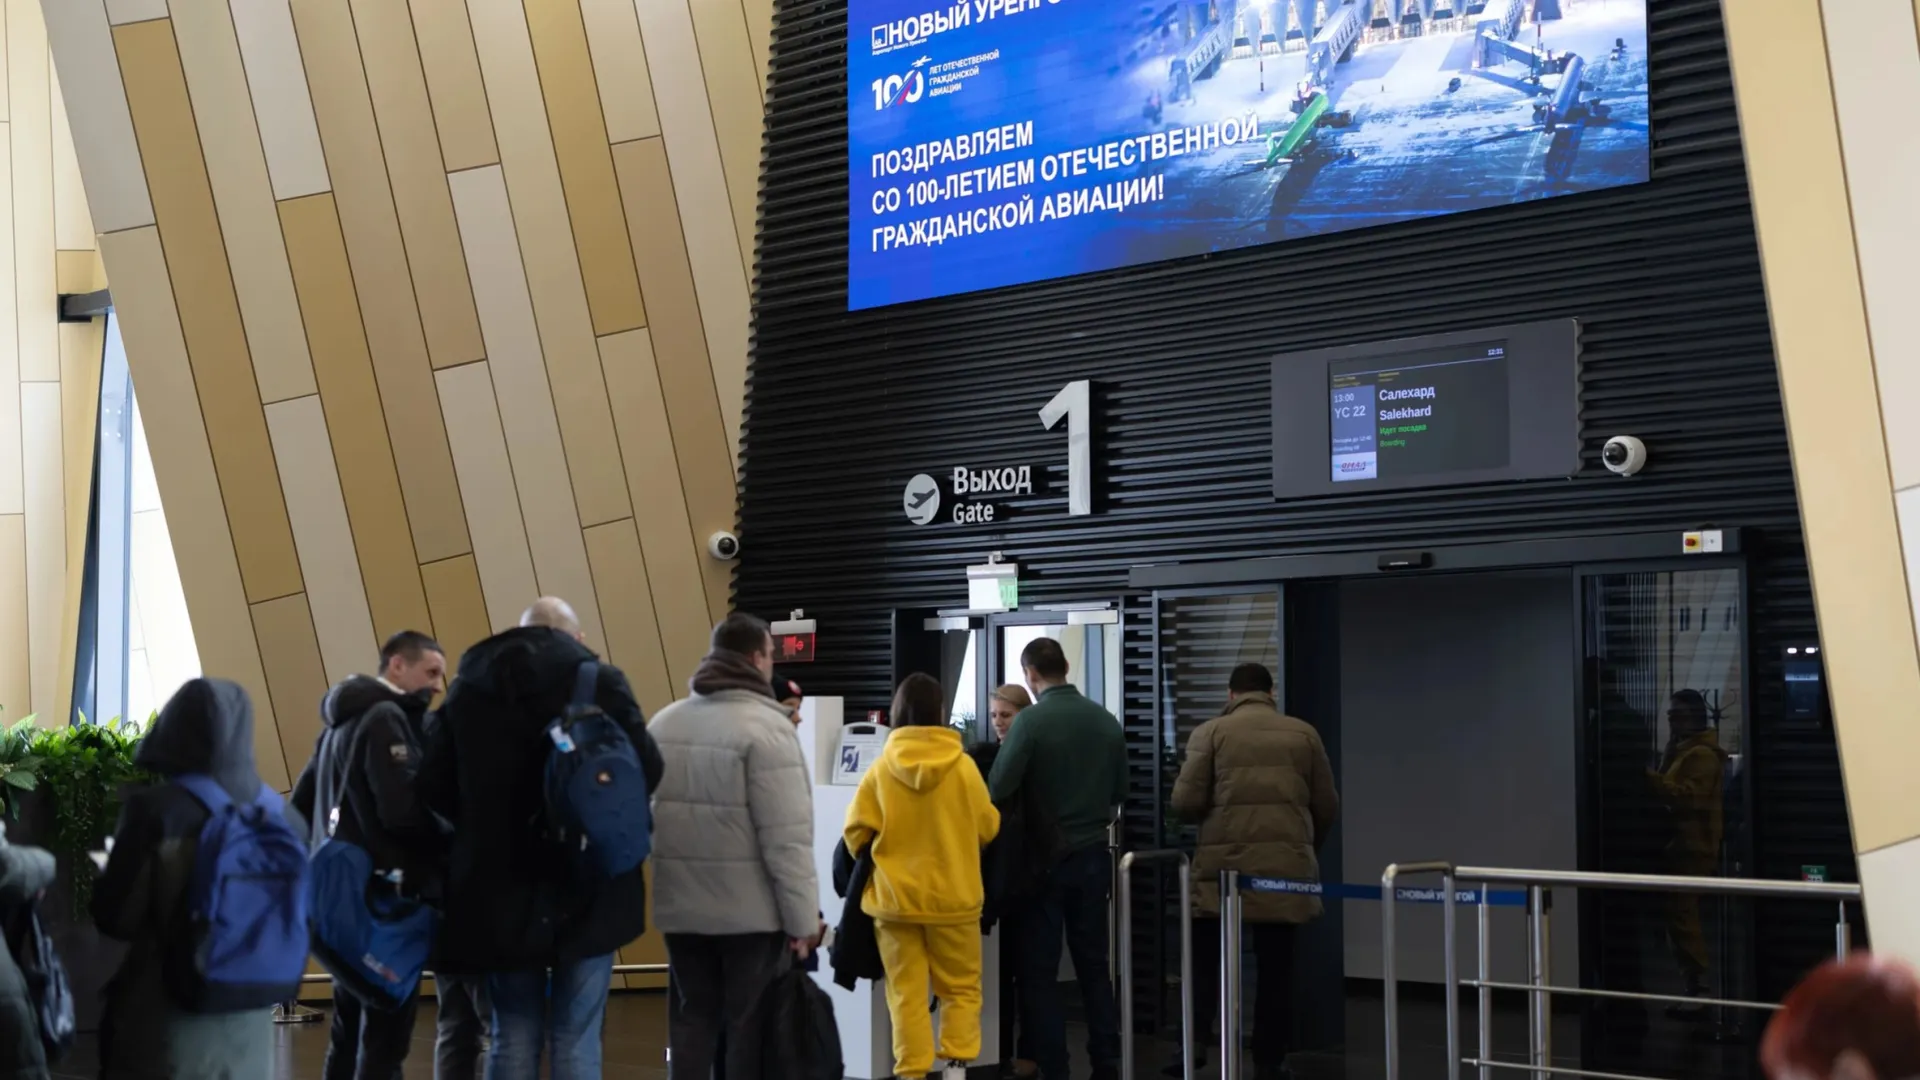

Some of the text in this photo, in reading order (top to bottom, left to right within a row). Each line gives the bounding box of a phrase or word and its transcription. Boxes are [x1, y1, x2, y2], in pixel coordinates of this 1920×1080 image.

[889, 0, 1061, 46] НОВЫЙ УРЕ
[929, 49, 1000, 75] ЛЕТ ОТЕЧЕСТВЕННОЙ
[929, 65, 979, 86] ГРАЖДАНСКОЙ
[872, 69, 924, 111] 100
[929, 82, 962, 97] АВИАЦИИ
[872, 120, 1034, 178] ПОЗДРАВЛЯЕМ
[872, 108, 1259, 215] СО 100-ЛЕТИЕМ ОТЕЧЕСТВЕННОЙ
[872, 173, 1165, 253] ГРАЖДАНСКОЙ АВИАЦИИ!
[1334, 393, 1355, 403] 13:00
[1379, 386, 1436, 402] Салехард
[1334, 405, 1366, 419] YC 22
[1379, 405, 1432, 421] Salekhard
[1038, 379, 1091, 516] 1
[953, 465, 1032, 495] Выход
[952, 502, 994, 525] Gate
